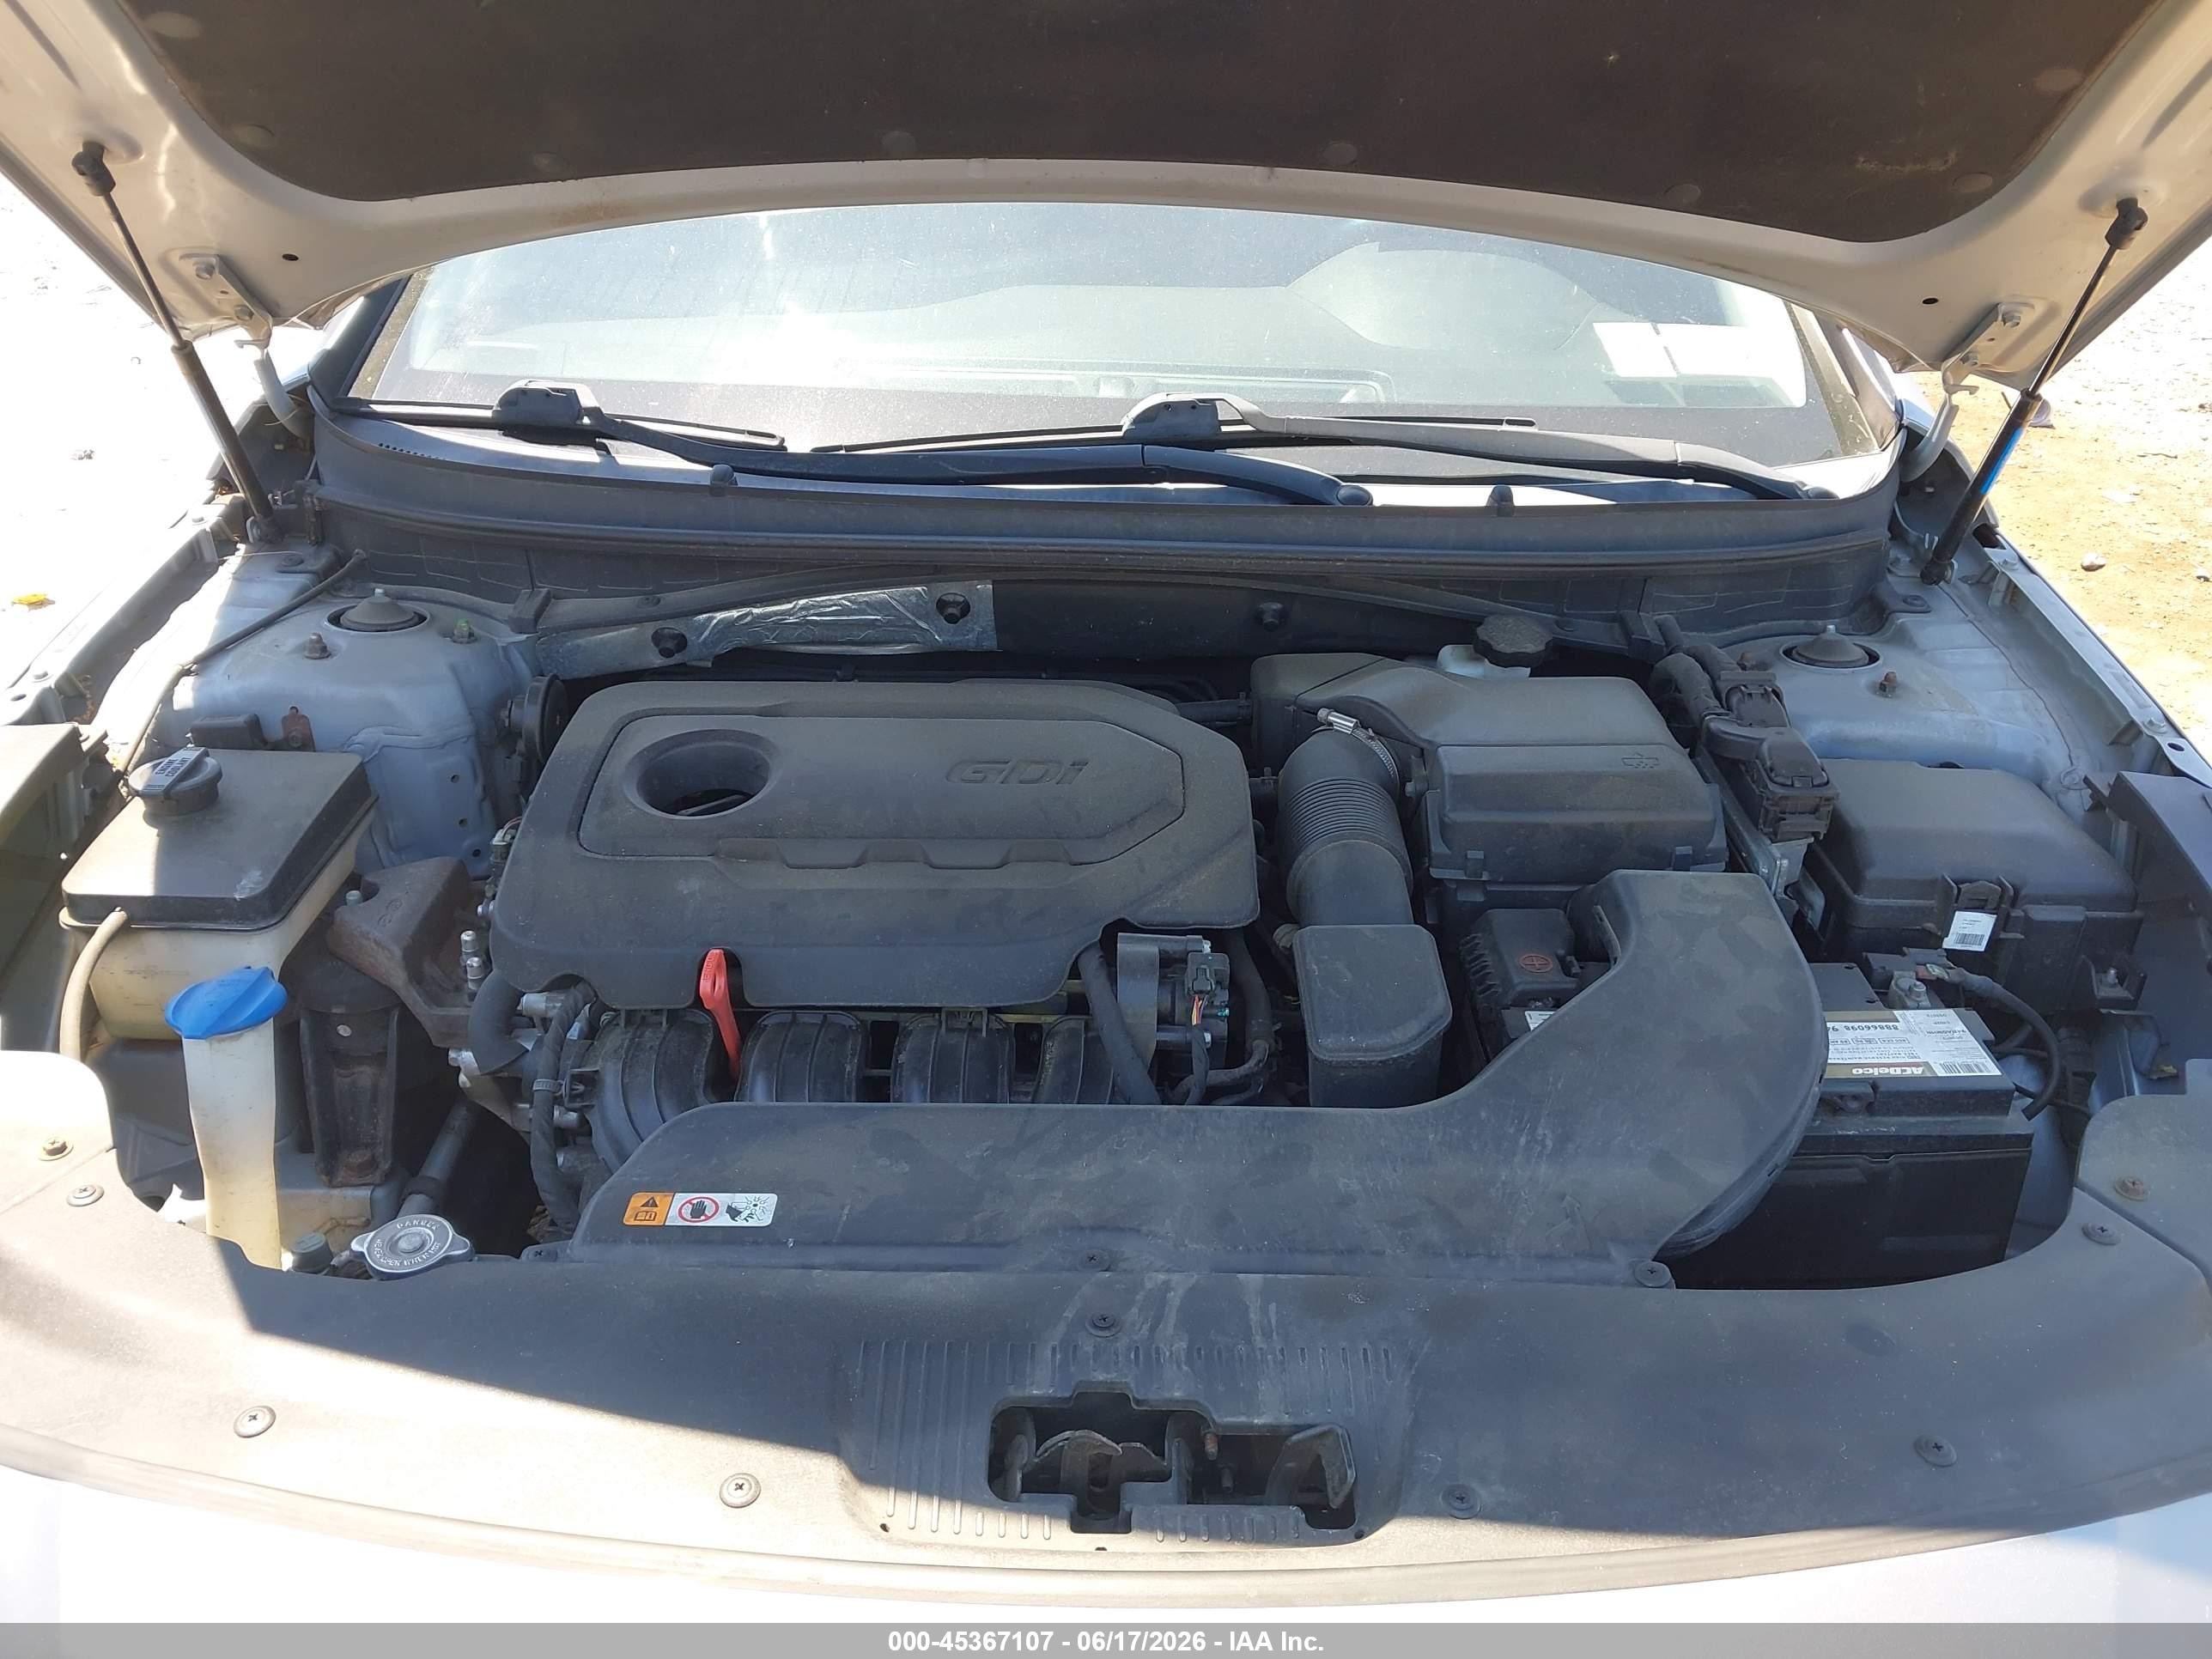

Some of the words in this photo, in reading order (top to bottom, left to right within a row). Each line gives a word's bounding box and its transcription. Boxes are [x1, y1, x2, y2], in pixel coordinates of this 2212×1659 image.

[155, 759, 179, 775] ENGINE
[165, 757, 191, 776] COOLANT
[945, 758, 1090, 785] GDi
